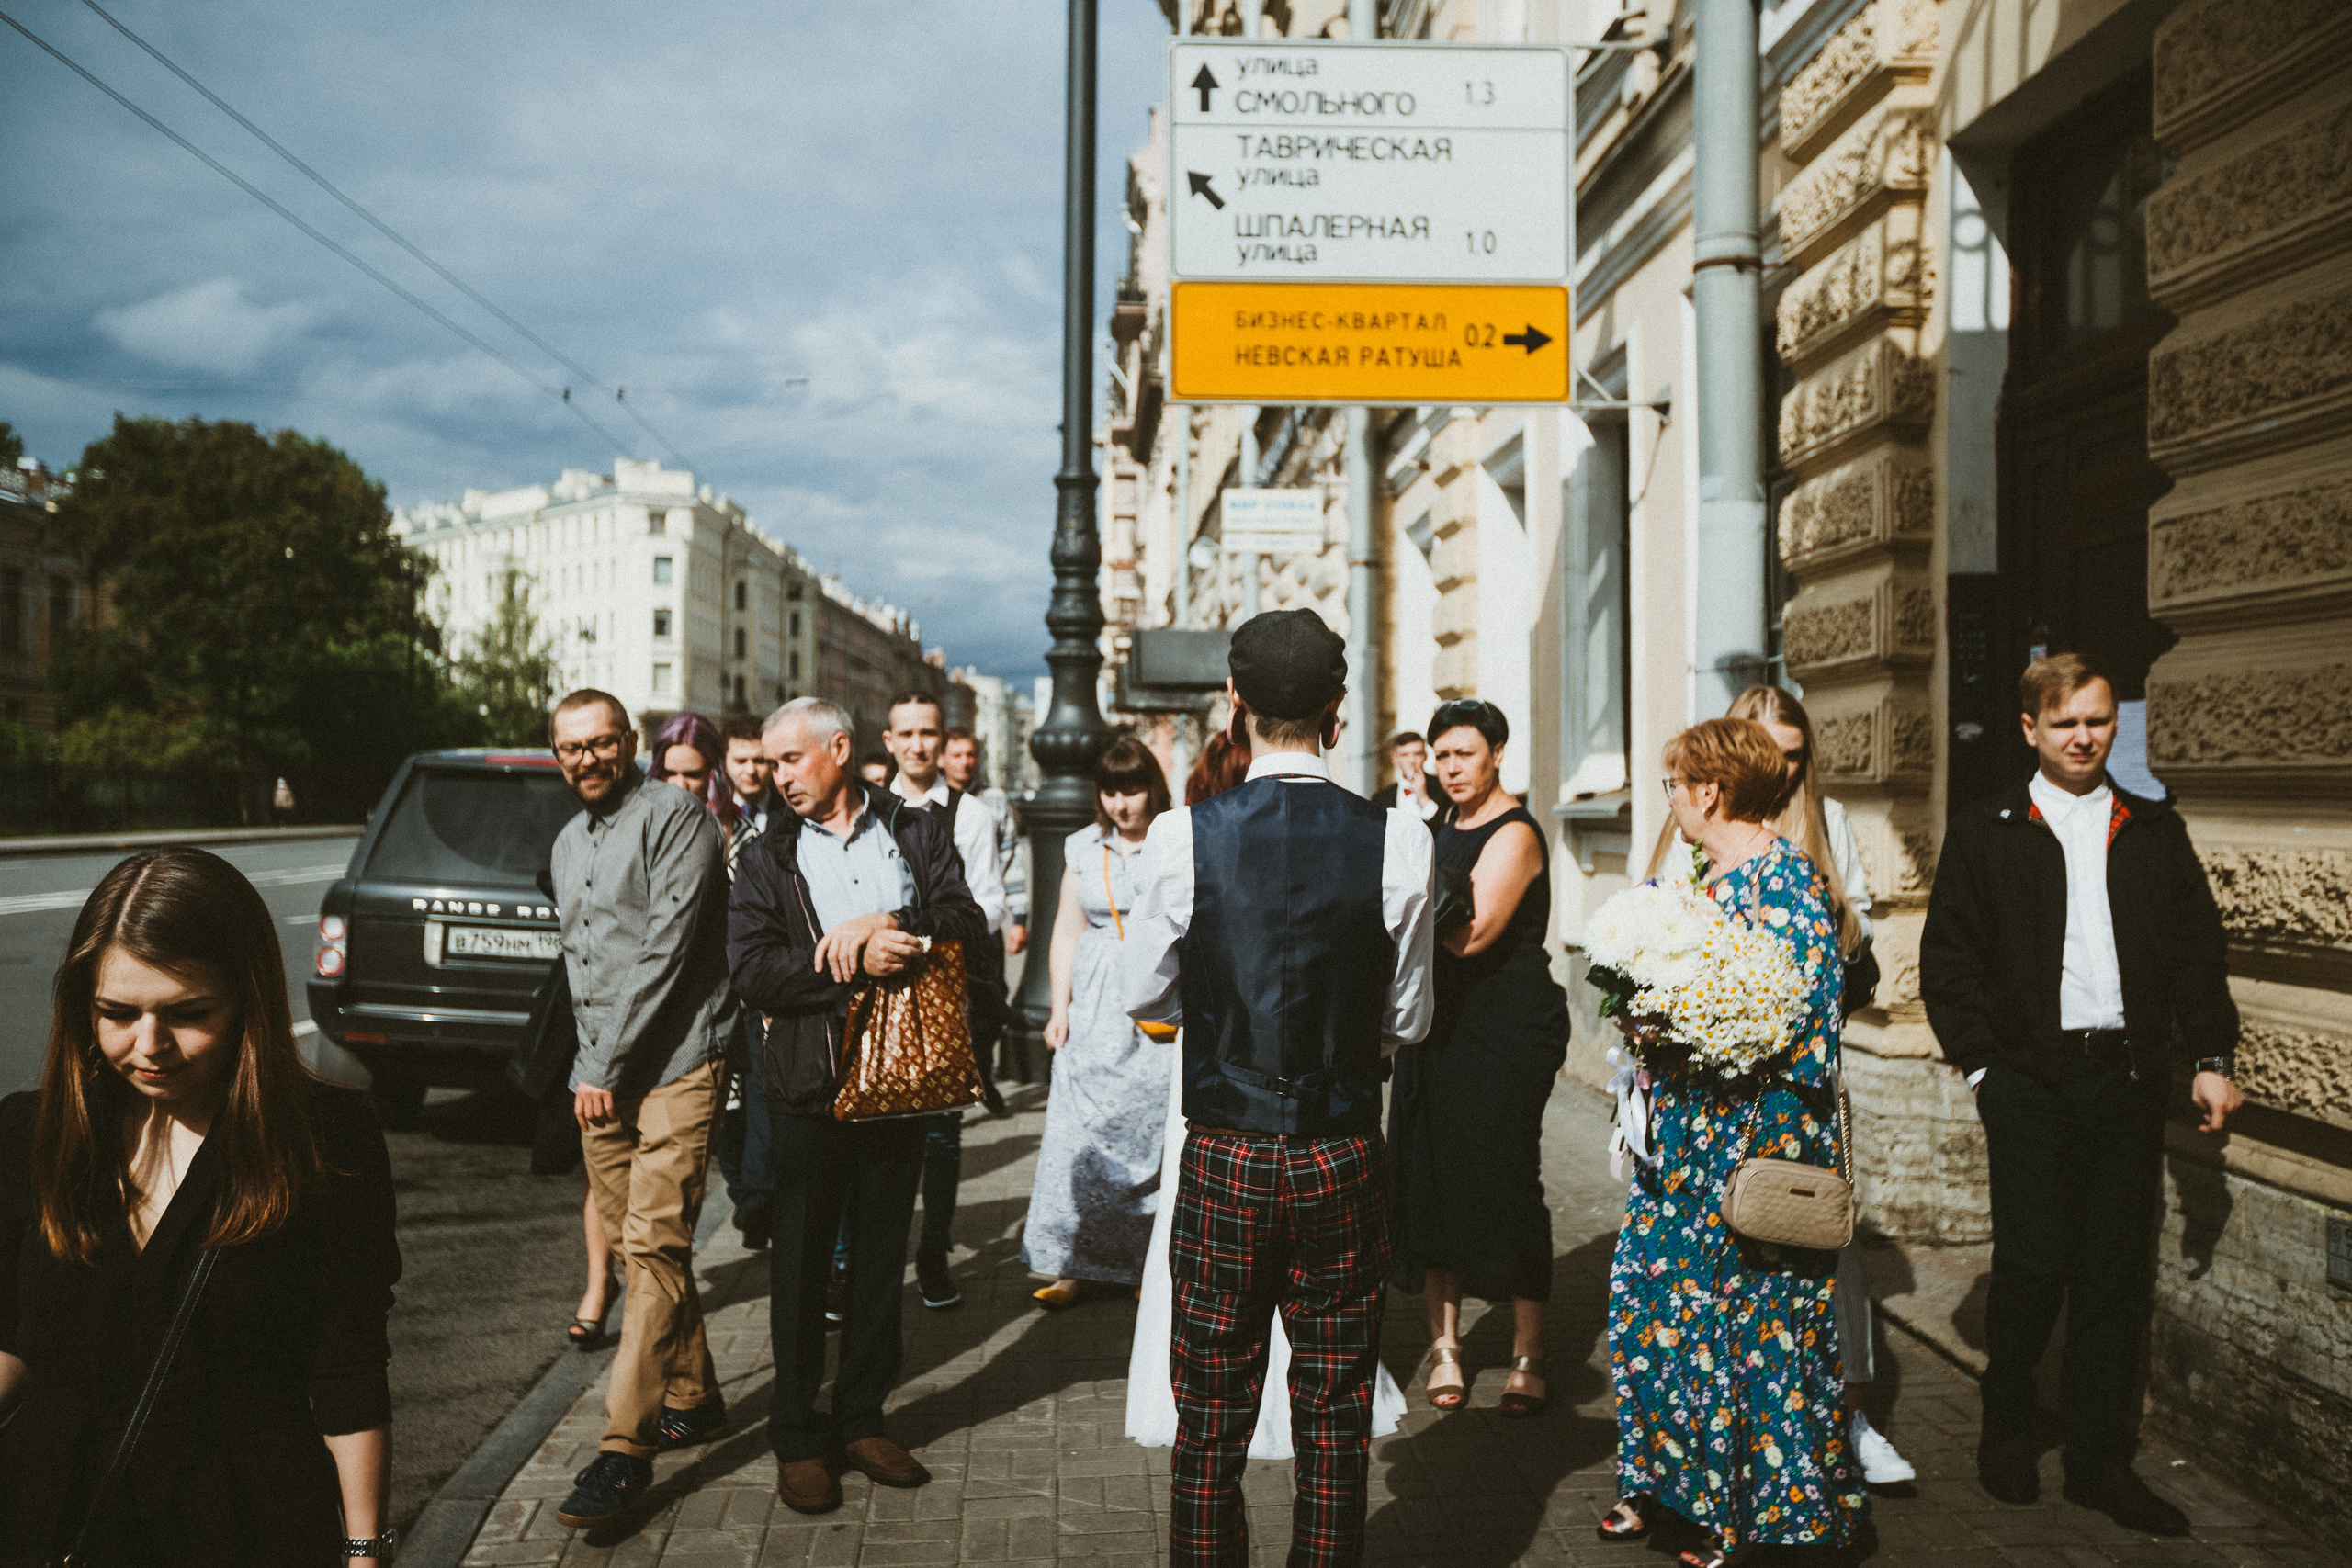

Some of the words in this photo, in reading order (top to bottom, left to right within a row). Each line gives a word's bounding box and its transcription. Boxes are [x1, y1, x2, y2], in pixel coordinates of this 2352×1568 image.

[1237, 57, 1318, 80] улица
[1235, 91, 1416, 116] СМОЛЬНОГО
[1237, 134, 1452, 161] ТАВРИЧЕСКАЯ
[1237, 167, 1320, 191] улица
[1235, 214, 1430, 239] ШПАЛЕРНАЯ
[1237, 243, 1317, 266] улица
[1235, 310, 1449, 331] БИЗНЕС-КВАРТАЛ
[1235, 344, 1351, 367] НЕВСКАЯ
[1359, 346, 1464, 368] РАТУША
[413, 898, 501, 917] RANGE
